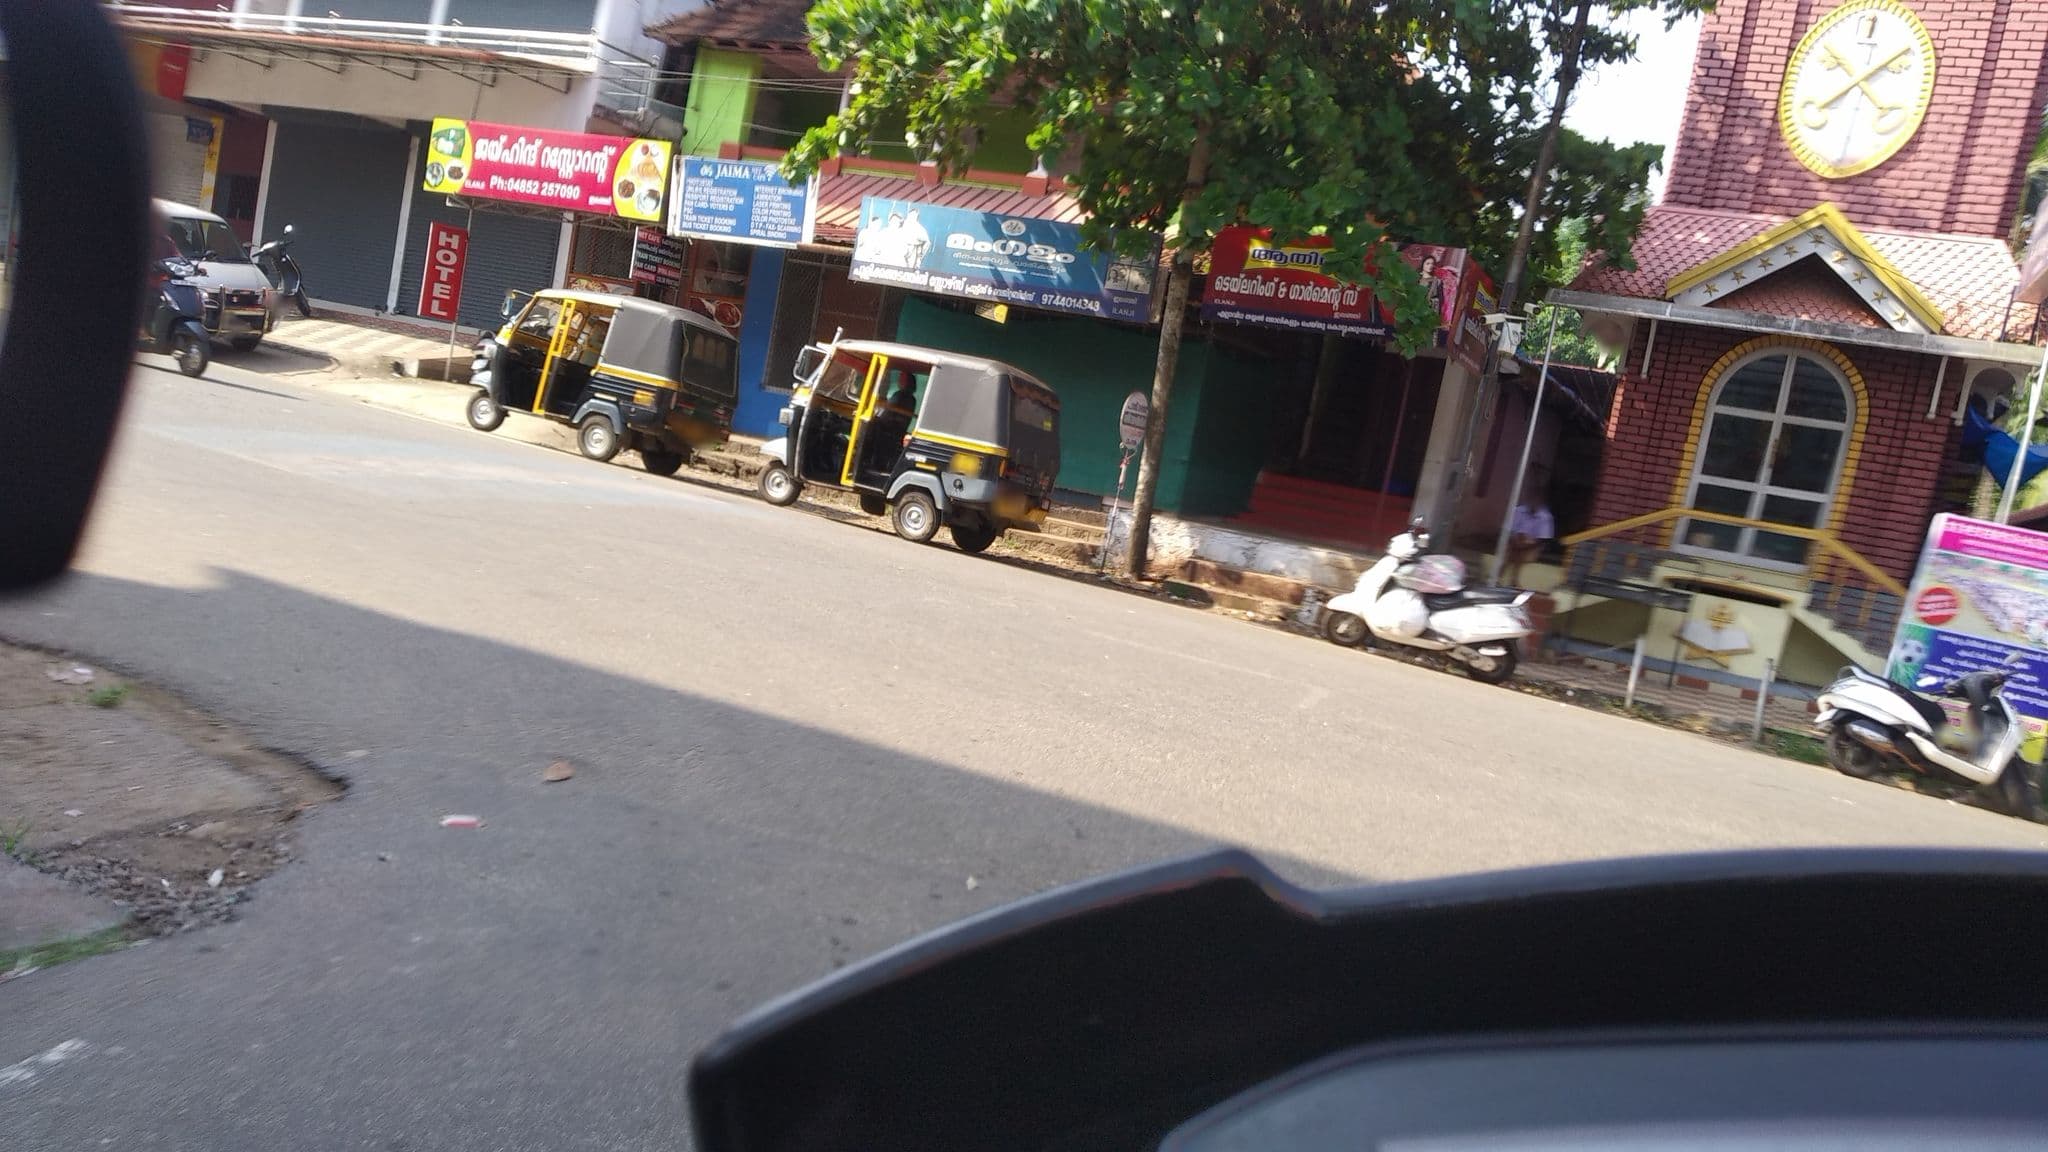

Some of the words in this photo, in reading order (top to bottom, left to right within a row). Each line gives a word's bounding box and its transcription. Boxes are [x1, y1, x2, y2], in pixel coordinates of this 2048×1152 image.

[715, 164, 750, 180] JAIMA
[490, 174, 539, 194] Ph:04852
[541, 181, 580, 199] 257090
[946, 233, 1075, 264] മംഗളം
[430, 230, 460, 317] HOTEL
